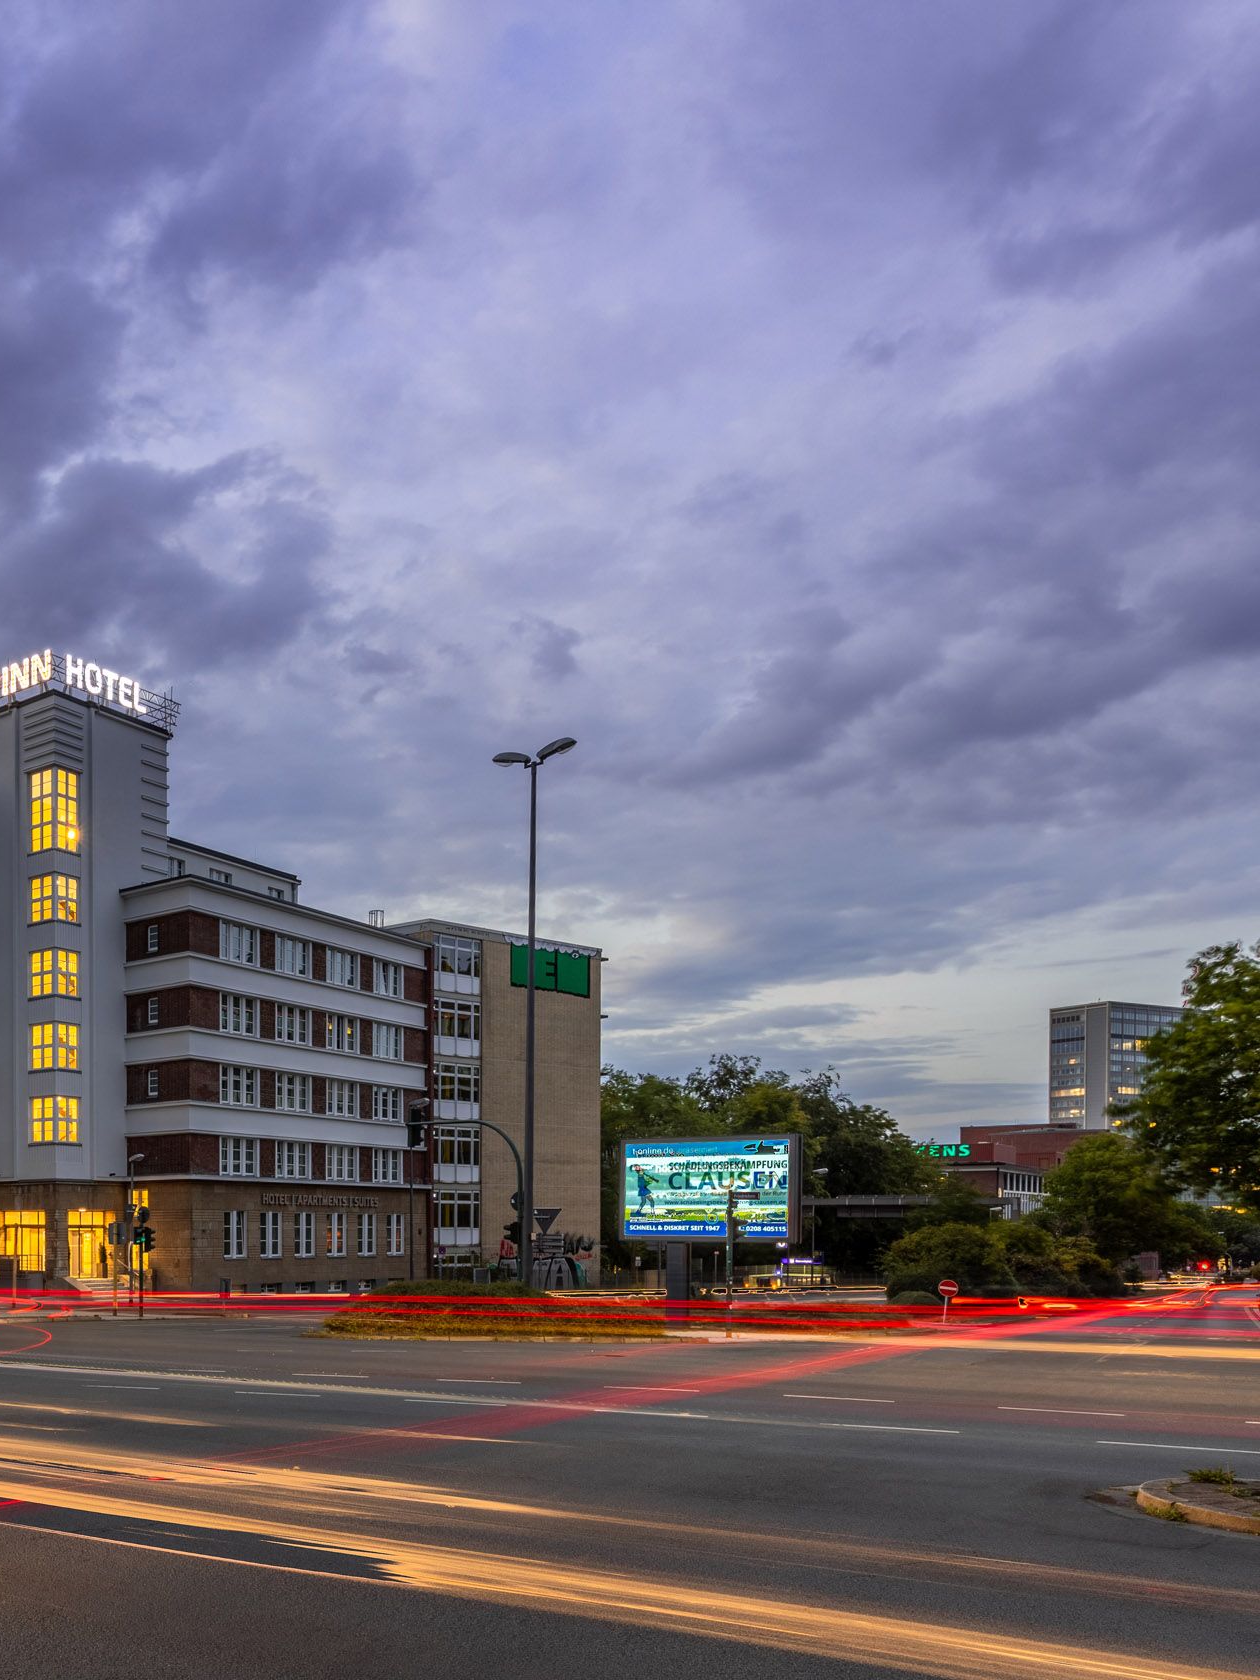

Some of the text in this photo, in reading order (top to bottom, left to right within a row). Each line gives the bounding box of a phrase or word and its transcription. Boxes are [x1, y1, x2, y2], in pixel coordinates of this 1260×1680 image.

[65, 653, 147, 714] HOTEL
[668, 1170, 788, 1190] CLAUSEN
[262, 1193, 380, 1208] HOTEL APARTMENTS SUITES
